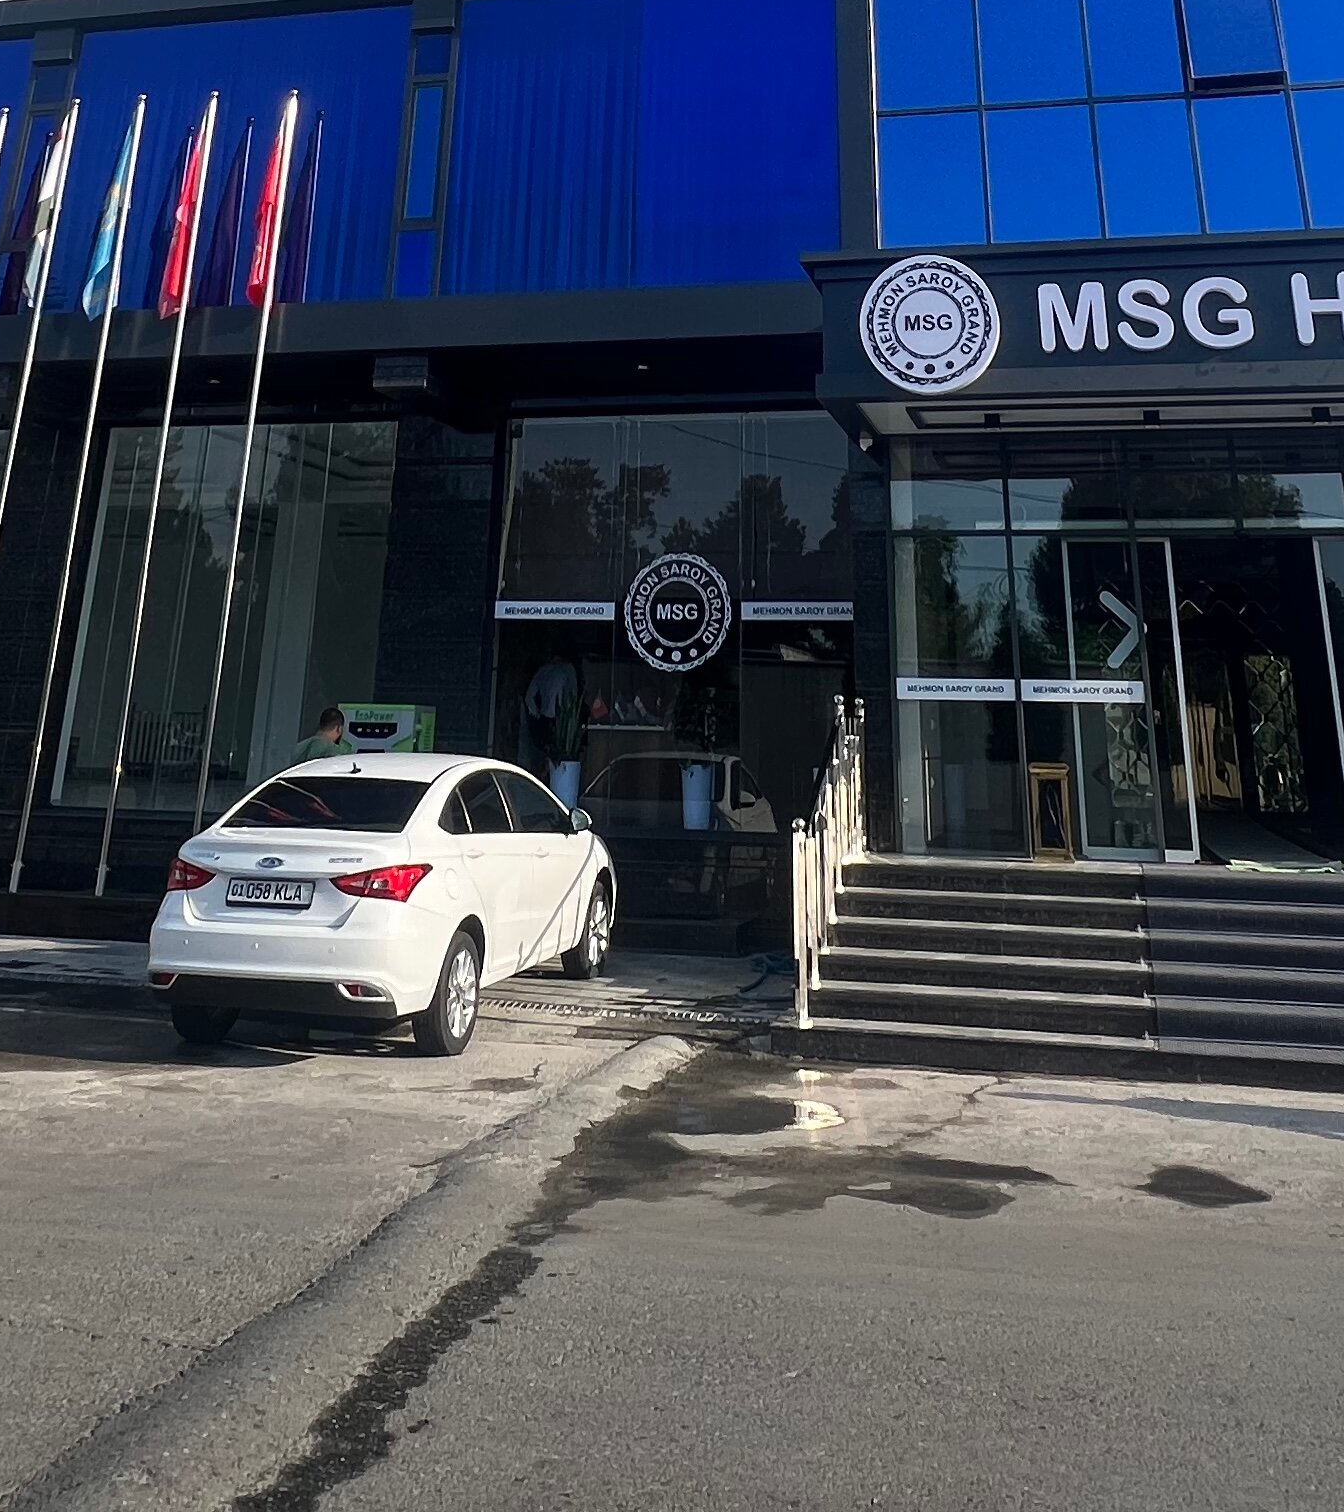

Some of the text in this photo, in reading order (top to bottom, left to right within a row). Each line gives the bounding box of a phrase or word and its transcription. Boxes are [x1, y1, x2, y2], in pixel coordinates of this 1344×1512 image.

[877, 272, 980, 357] MEHMON SAROY GRAND
[904, 314, 953, 331] MSG
[1037, 276, 1256, 353] MSG
[504, 606, 605, 616] MEHMON SAROY GRAND
[633, 563, 722, 645] MEHMON SAROY GRAND
[656, 603, 698, 621] MSG
[752, 606, 853, 616] MEHMON SAROY GRAN
[907, 684, 1005, 694] MEHMON SAROY GRAND
[1032, 685, 1134, 696] MEHMON SAROY GRAND
[231, 883, 302, 901] 01 058 KLA
